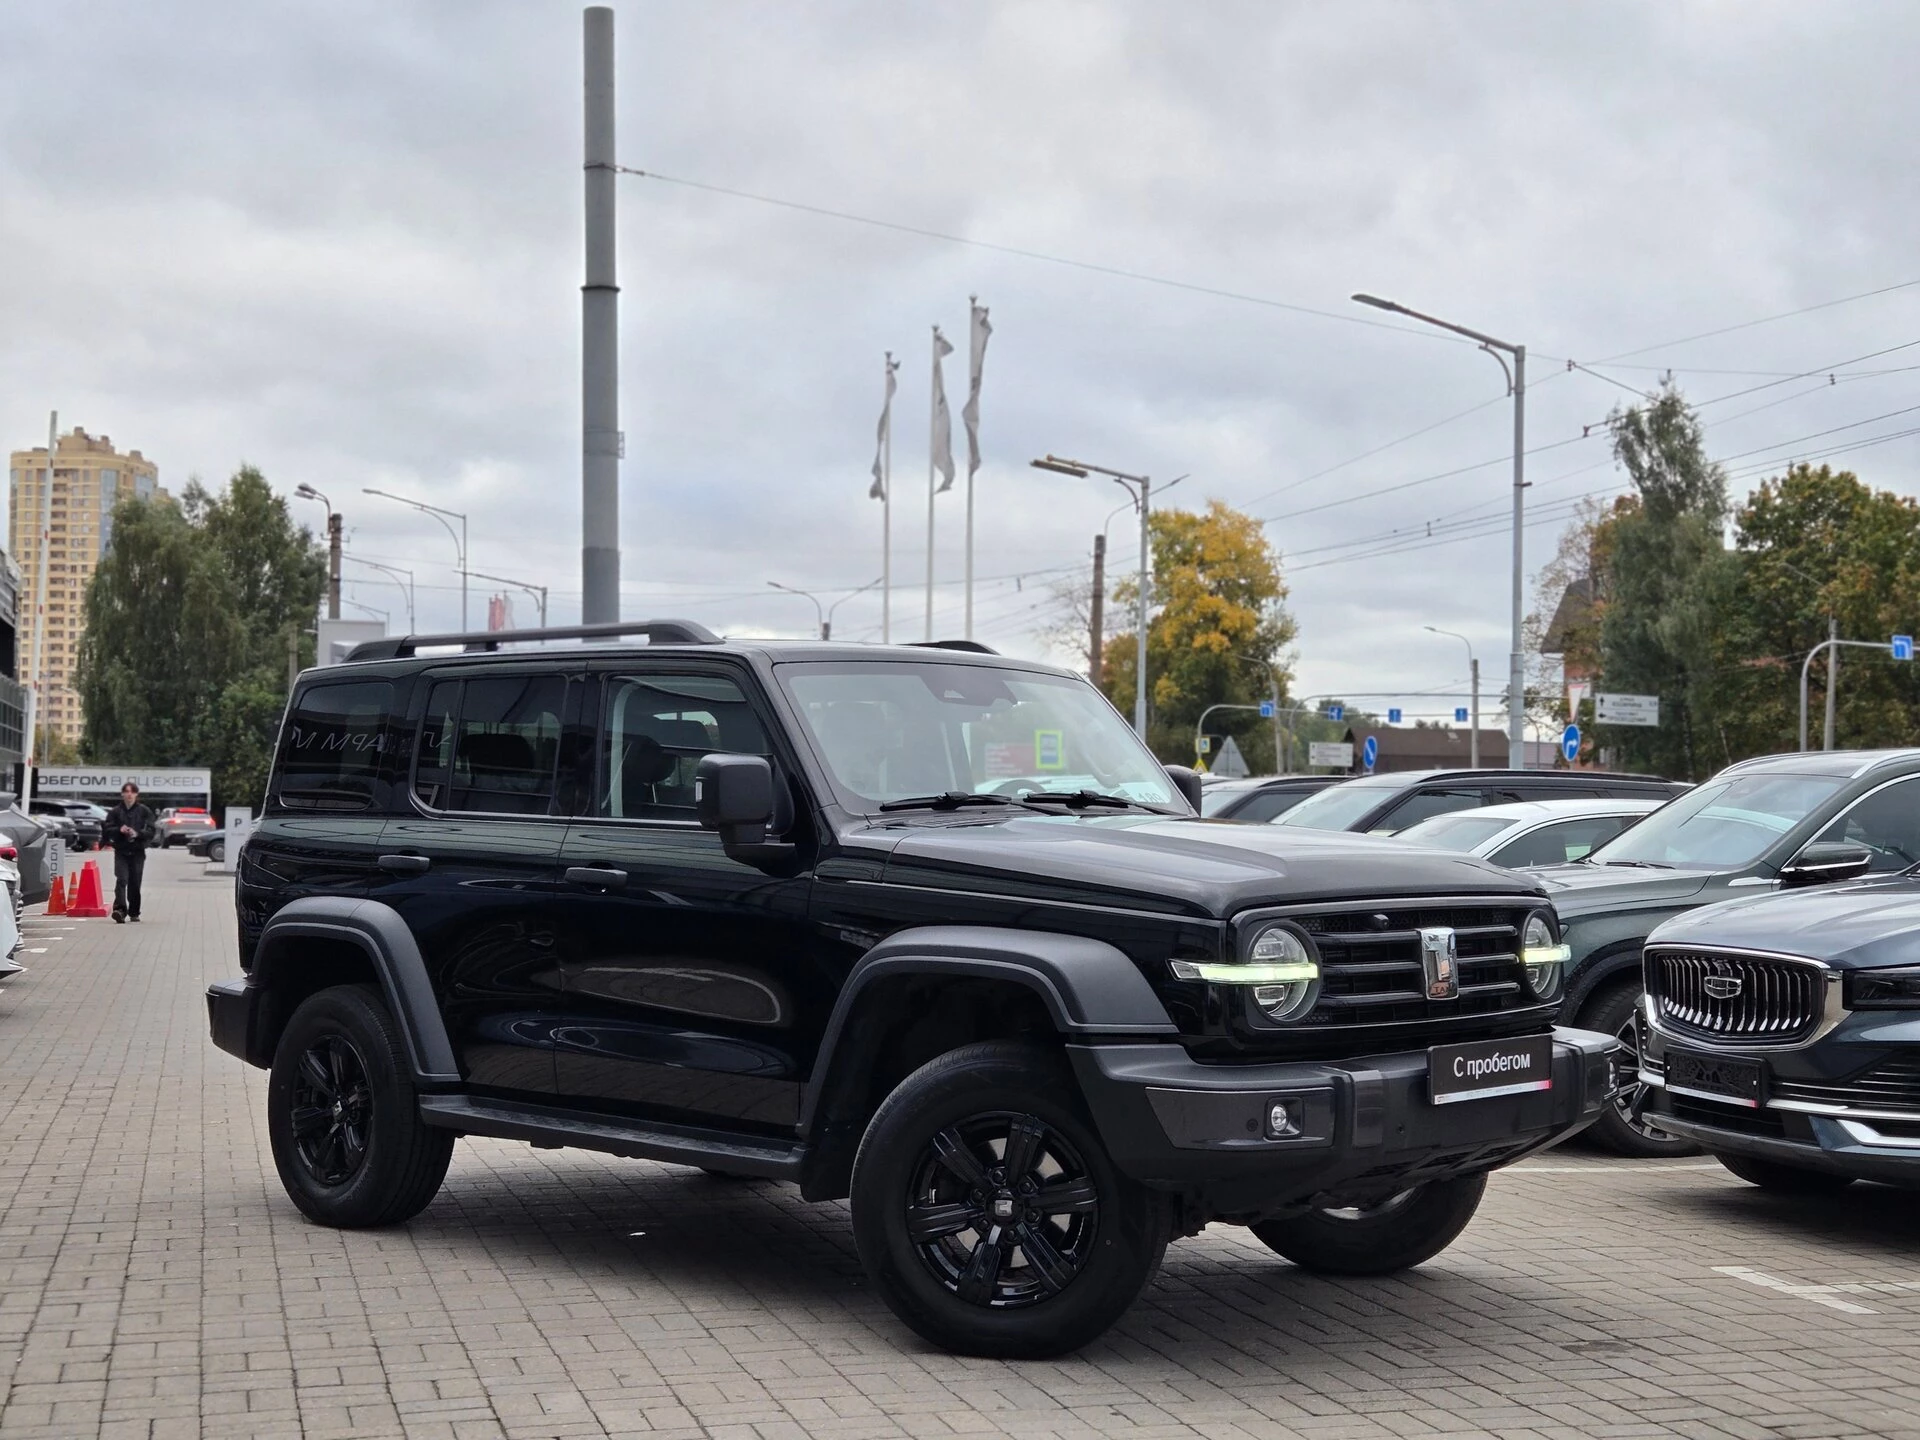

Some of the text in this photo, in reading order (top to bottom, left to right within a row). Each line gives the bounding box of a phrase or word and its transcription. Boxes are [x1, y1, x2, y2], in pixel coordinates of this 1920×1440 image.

[38, 775, 106, 786] ОБЕГОМ
[152, 776, 204, 787] EXEED
[234, 818, 242, 828] P
[1453, 1052, 1531, 1079] С пробегом
